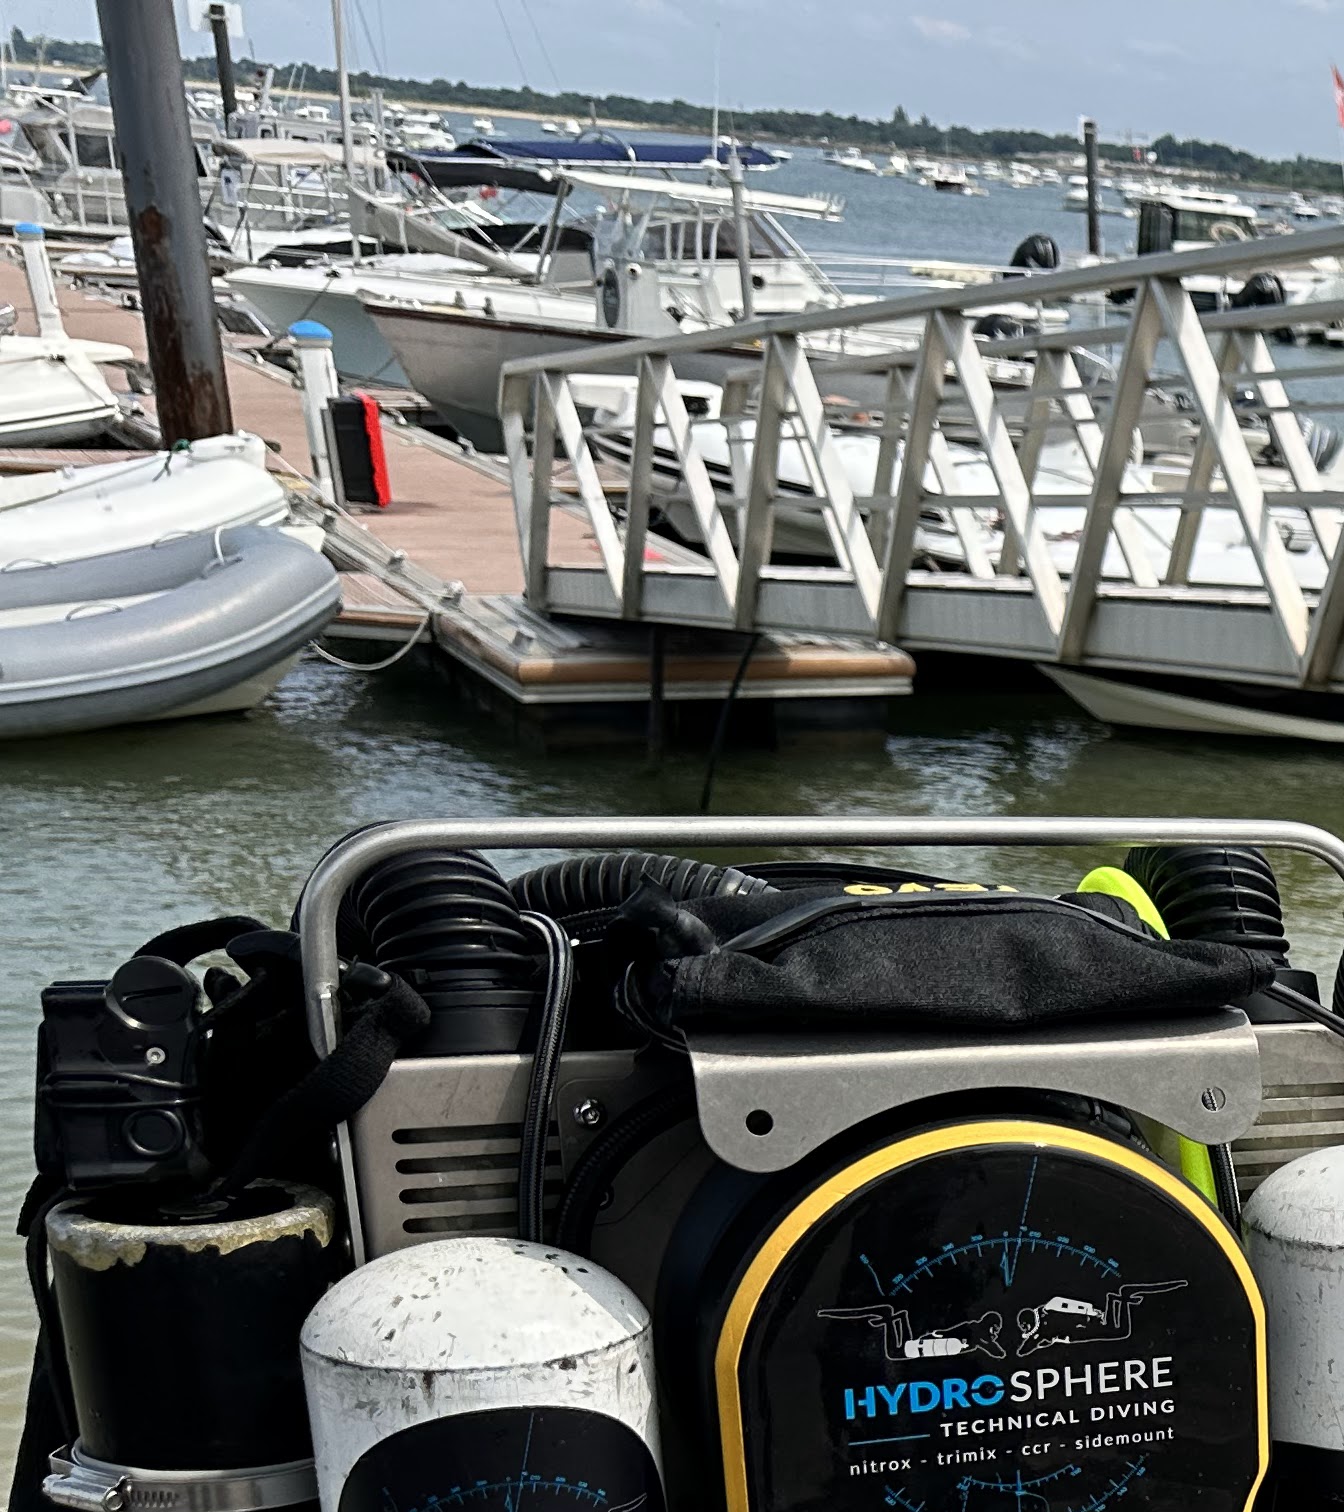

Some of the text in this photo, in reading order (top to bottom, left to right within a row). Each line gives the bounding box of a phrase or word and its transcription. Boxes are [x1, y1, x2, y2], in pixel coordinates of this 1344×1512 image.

[844, 1356, 1174, 1420] HYDROSPHERE
[940, 1399, 1176, 1438] TECHNICAL DIVING
[849, 1456, 912, 1476] nitrox
[937, 1447, 997, 1466] trimix
[1021, 1442, 1051, 1456] ccr
[1075, 1427, 1175, 1450] sidemount
